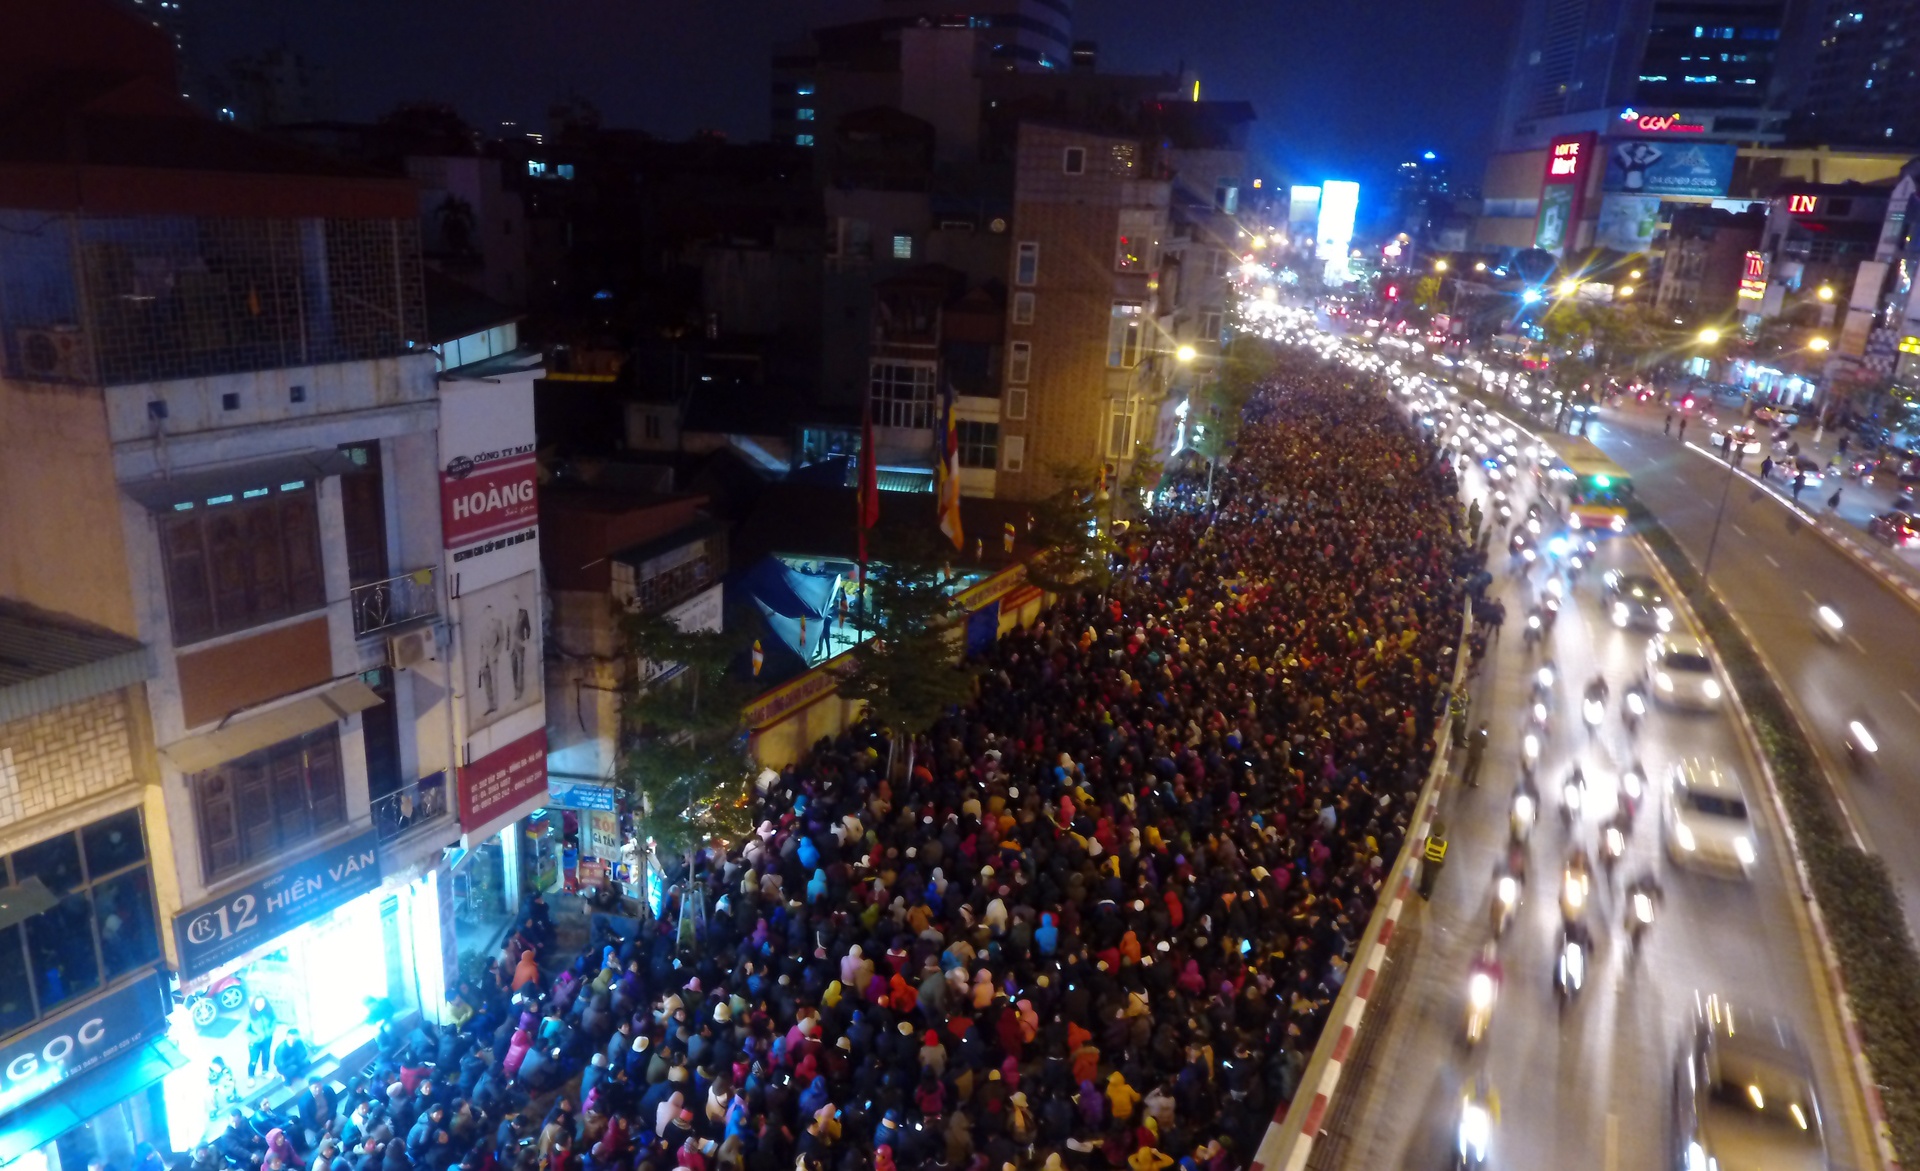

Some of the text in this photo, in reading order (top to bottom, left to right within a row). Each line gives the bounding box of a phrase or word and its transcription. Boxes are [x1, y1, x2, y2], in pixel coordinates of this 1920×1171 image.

[1639, 115, 1673, 131] CGV
[1554, 143, 1580, 156] LOTTE
[1789, 195, 1818, 213] IN
[1748, 259, 1764, 276] IN
[474, 443, 534, 463] CÔNG TY MAY
[453, 479, 534, 520] HOÀNG
[328, 849, 375, 882] VÂN
